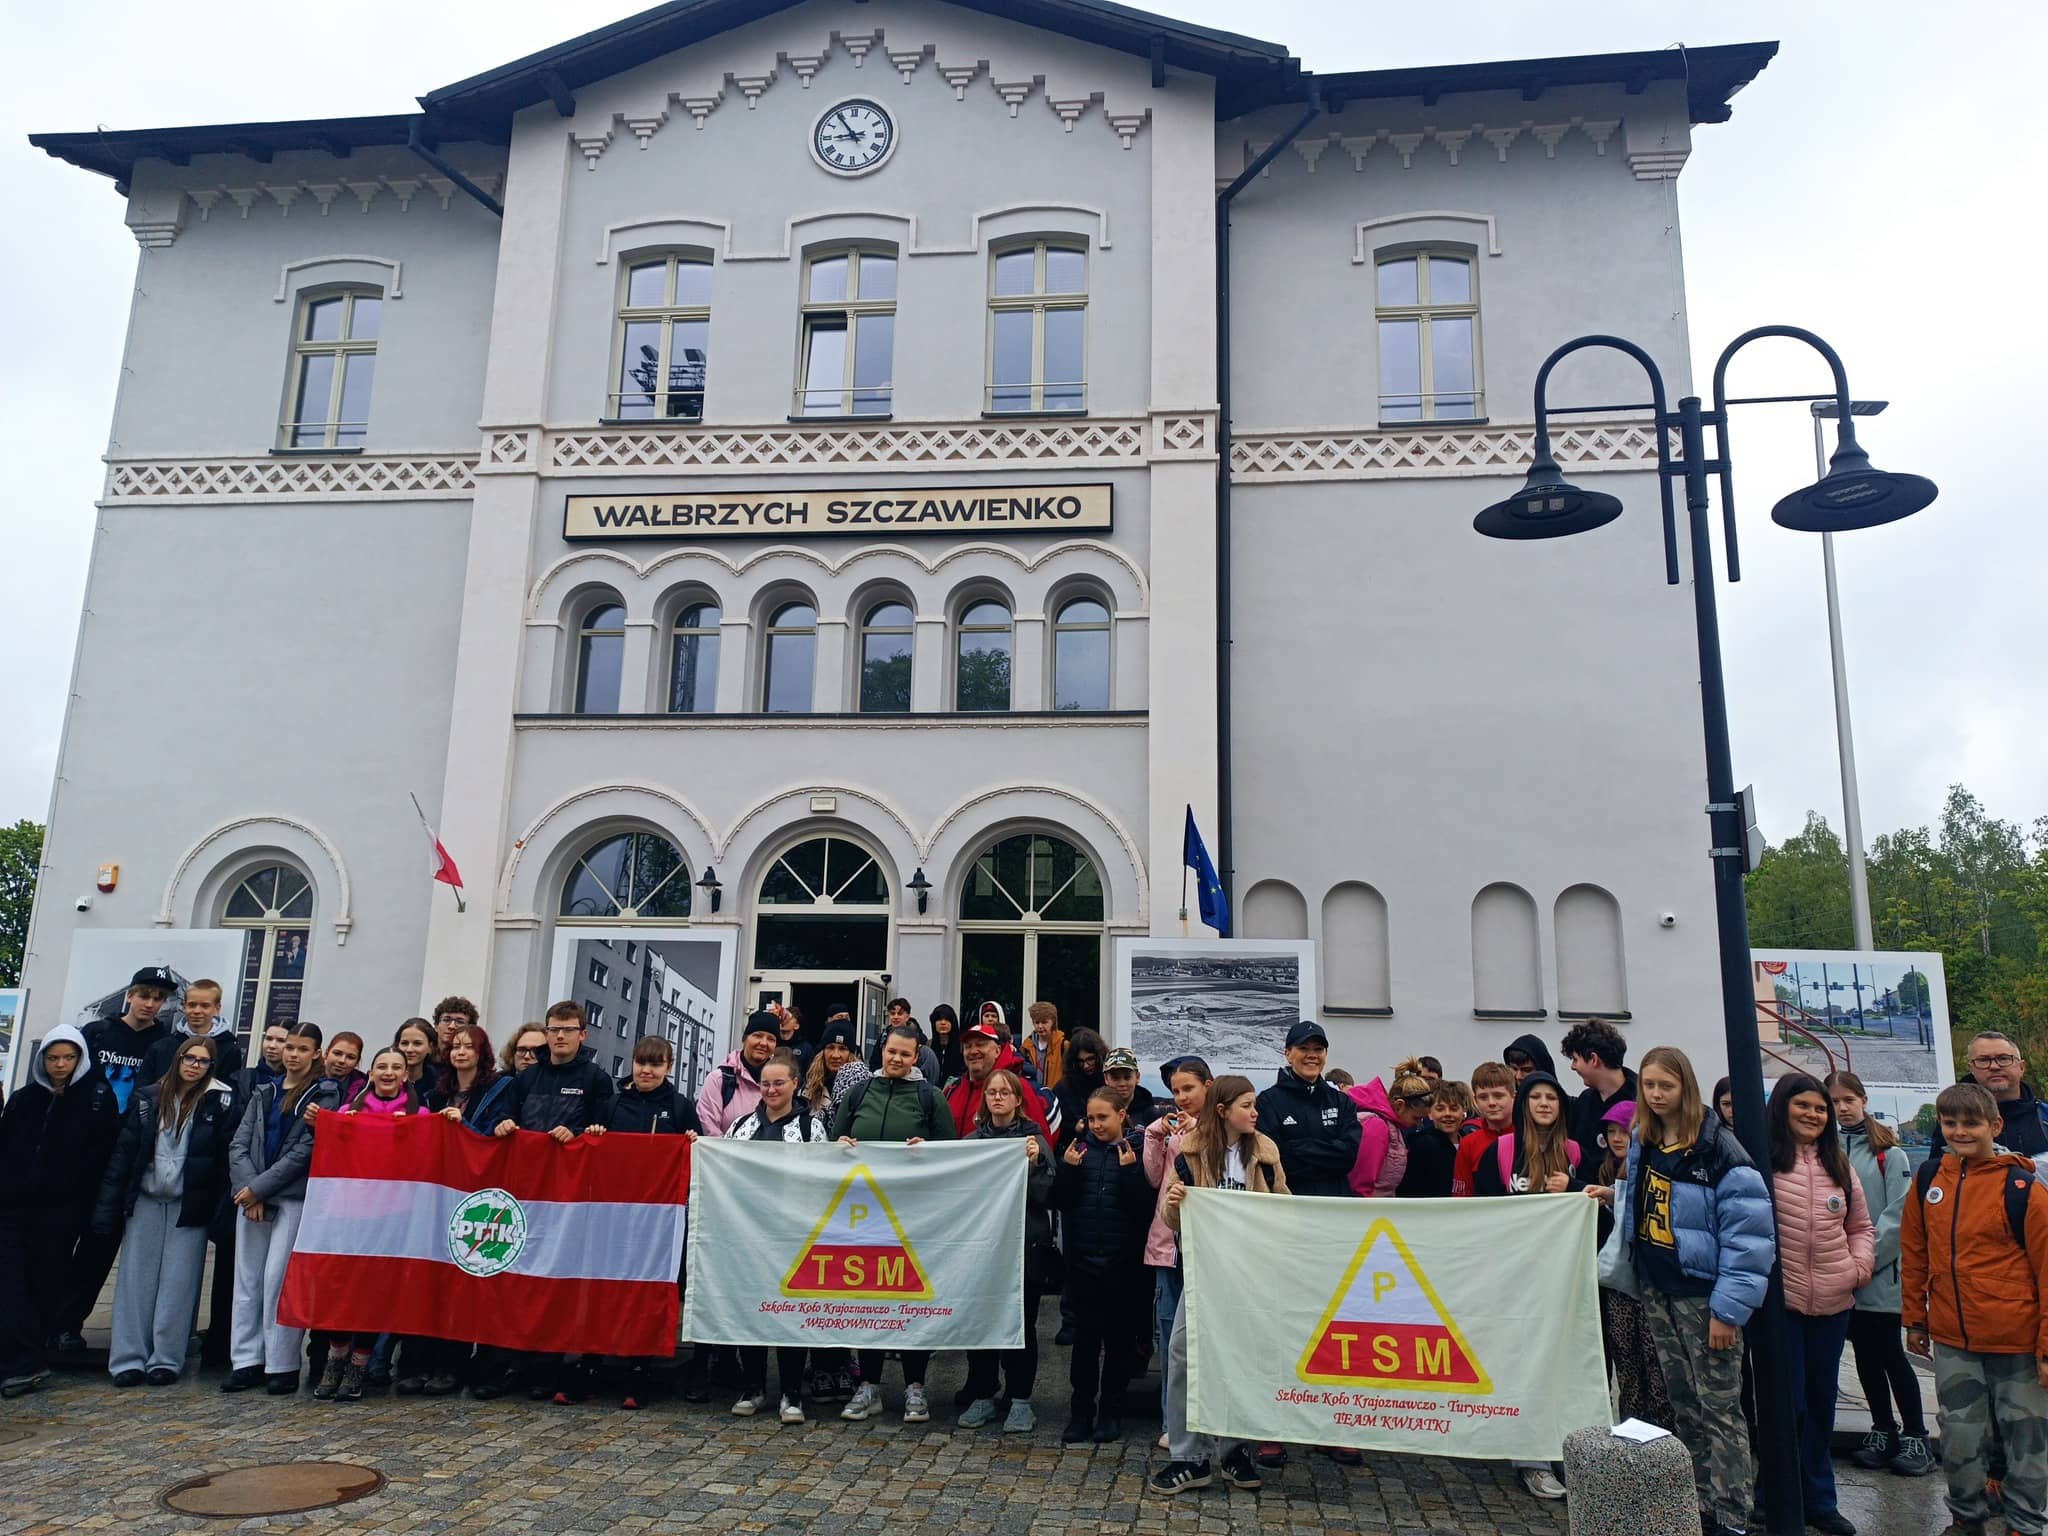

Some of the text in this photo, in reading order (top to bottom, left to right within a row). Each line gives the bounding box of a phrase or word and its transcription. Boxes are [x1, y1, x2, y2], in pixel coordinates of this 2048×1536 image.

[593, 496, 1081, 528] WAŁBRZYCH SZCZAWIENKO
[849, 1203, 869, 1229] P
[456, 1220, 515, 1245] PTTK
[1373, 1271, 1397, 1304] P
[758, 1301, 796, 1314] Szkolne
[798, 1302, 821, 1314] Koło
[823, 1303, 890, 1315] Krajoznawczo
[898, 1304, 953, 1318] Turystyczne
[1275, 1389, 1319, 1404] Szkolne
[1321, 1392, 1350, 1405] Koło
[1352, 1394, 1437, 1411] Krajoznawczo
[1447, 1400, 1520, 1418] Turystyczne
[1333, 1412, 1452, 1434] TEAM KWIATKI
